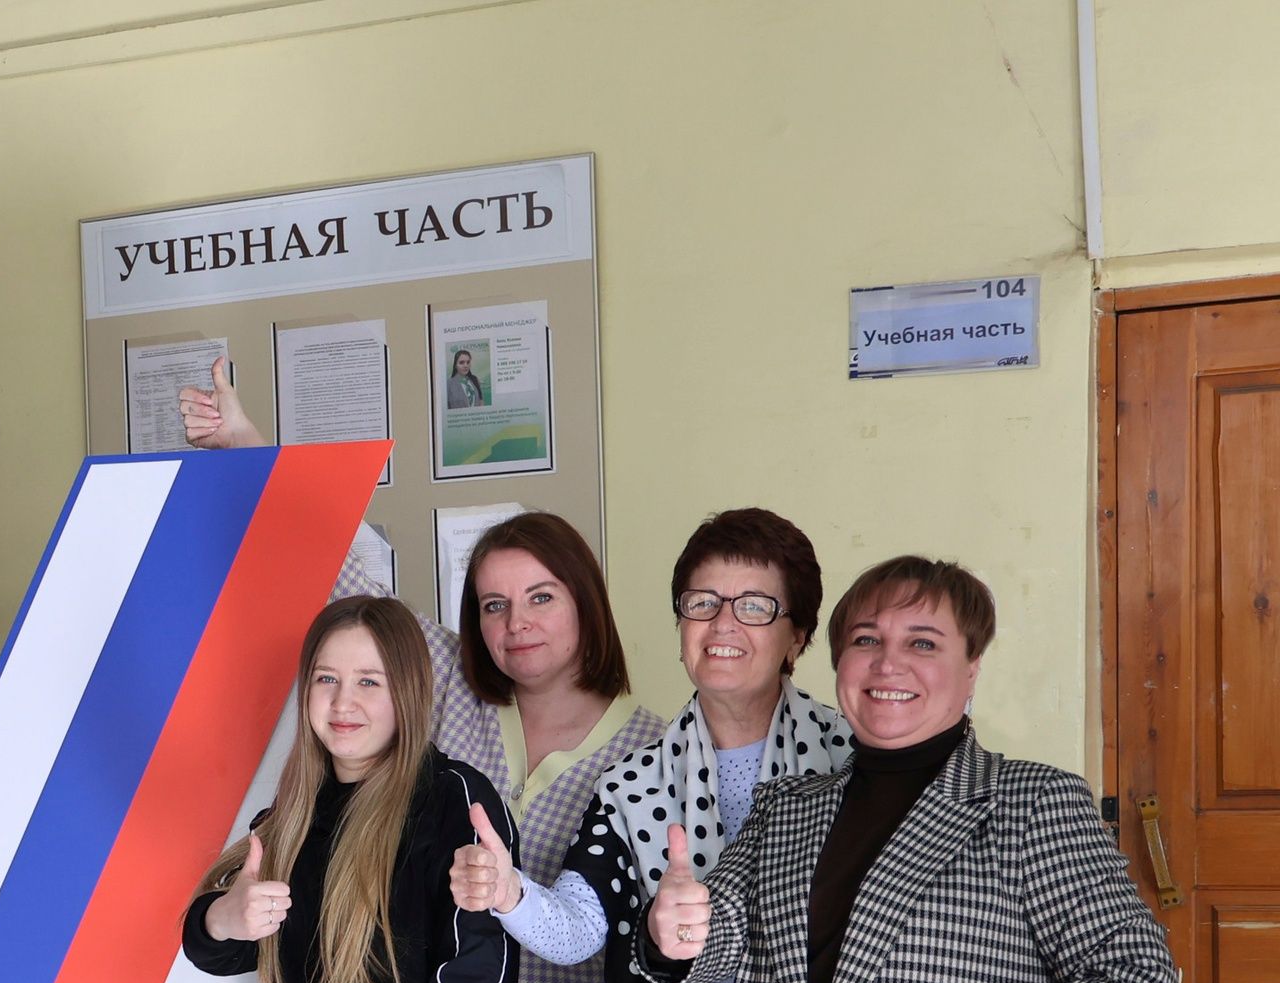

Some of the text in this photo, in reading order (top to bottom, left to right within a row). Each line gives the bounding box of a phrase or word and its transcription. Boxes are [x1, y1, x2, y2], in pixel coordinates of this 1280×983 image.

[115, 190, 554, 281] УЧЕБНАЯ ЧАСТЬ
[981, 278, 1026, 299] 104
[863, 322, 1026, 347] Учебная часть
